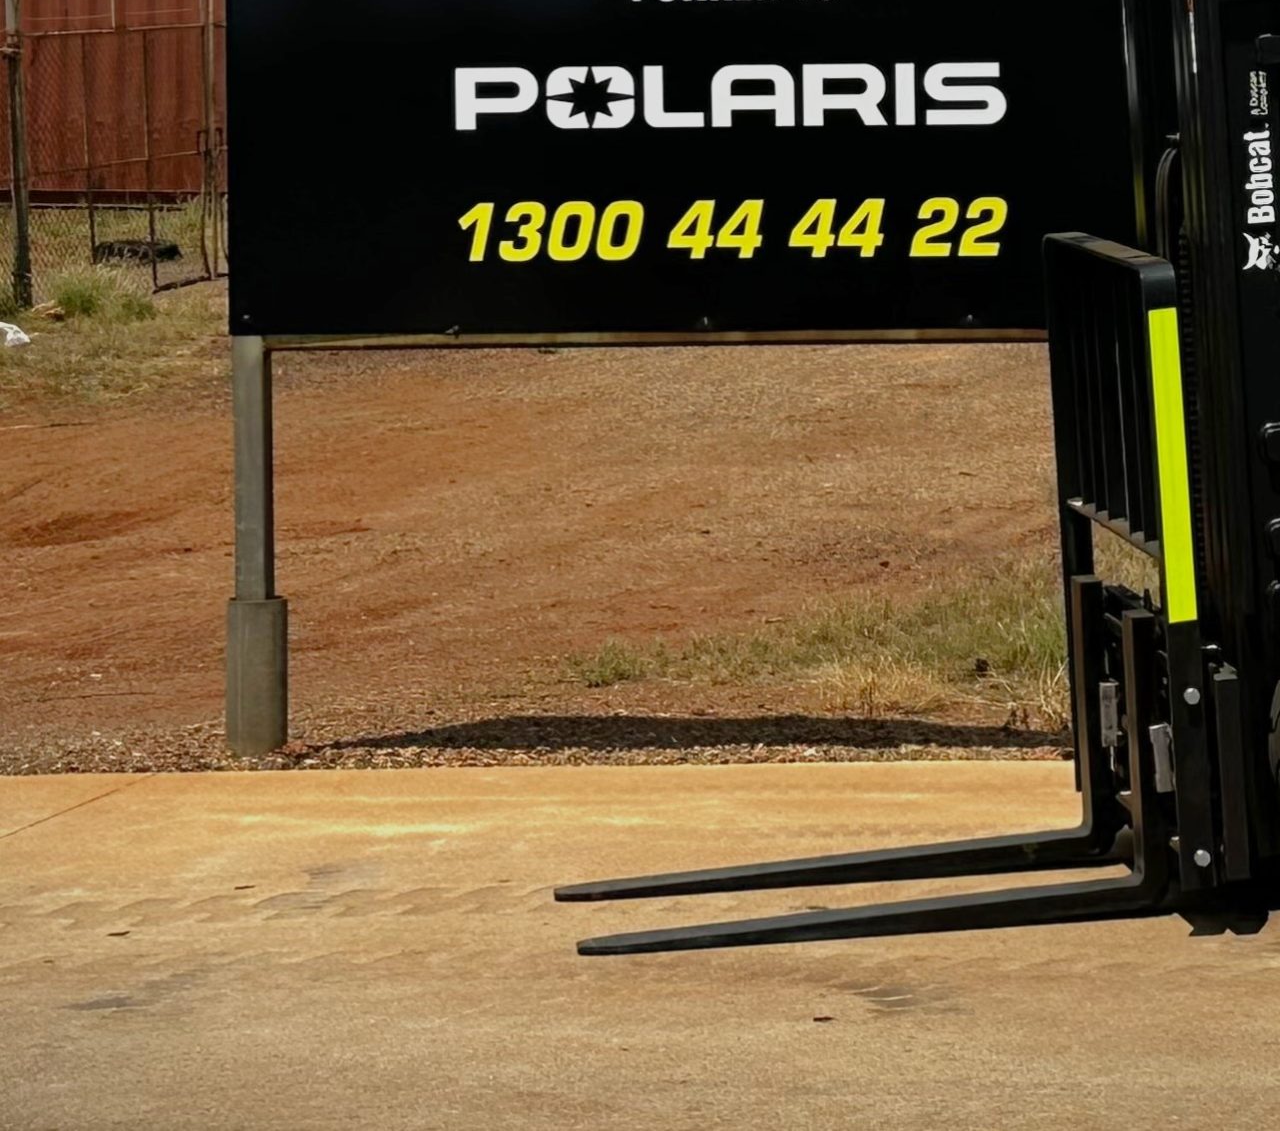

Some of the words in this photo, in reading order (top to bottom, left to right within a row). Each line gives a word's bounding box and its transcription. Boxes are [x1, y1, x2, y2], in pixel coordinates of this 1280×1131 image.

[454, 62, 1007, 131] POLARIS
[1243, 131, 1276, 225] Bobcat
[458, 200, 645, 262] 1300
[667, 199, 764, 260] 44
[788, 198, 886, 258] 44
[908, 196, 1008, 257] 22
